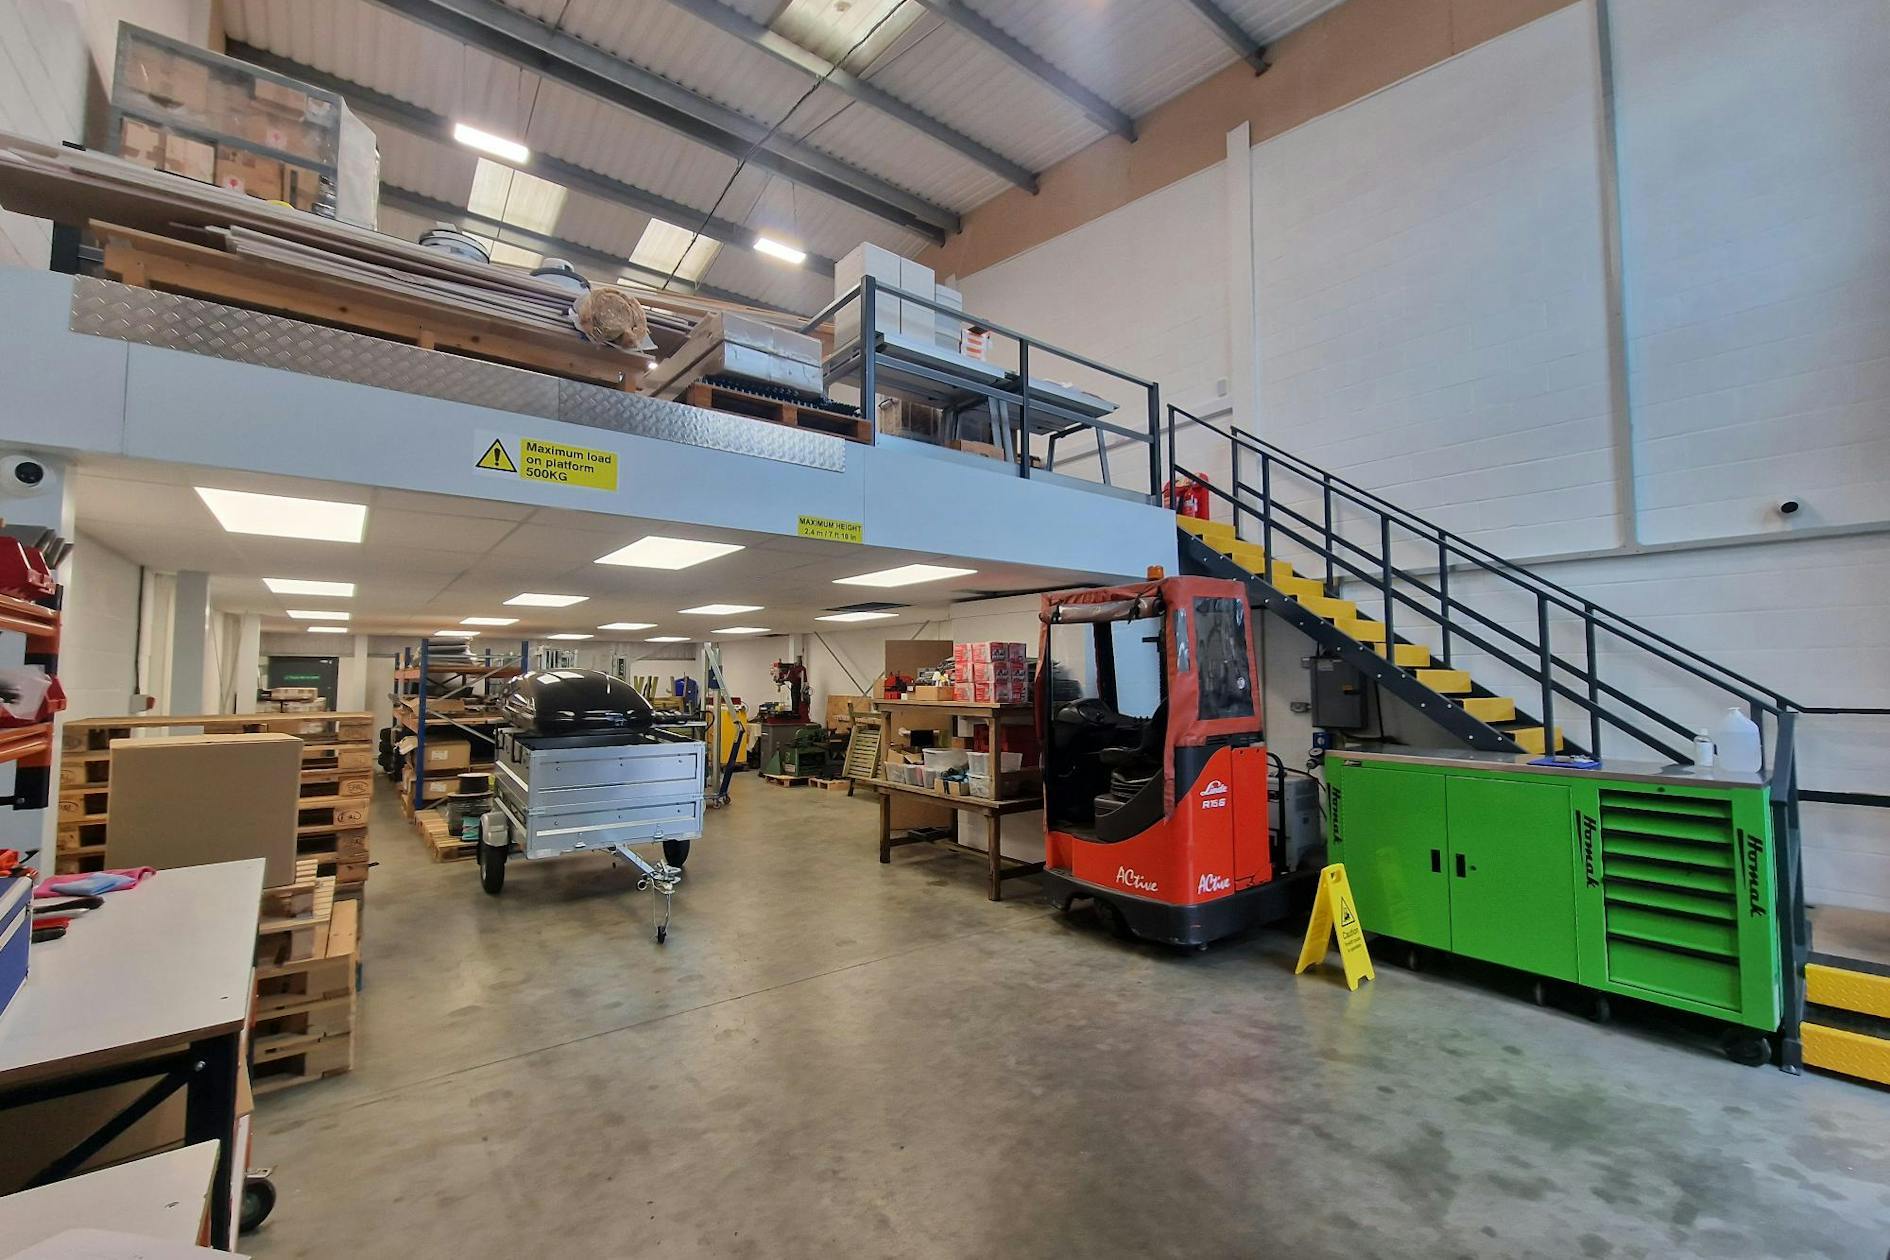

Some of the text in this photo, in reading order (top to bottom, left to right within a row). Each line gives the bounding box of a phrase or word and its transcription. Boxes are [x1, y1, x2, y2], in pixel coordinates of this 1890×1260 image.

[526, 441, 612, 464] Maximum load
[526, 456, 595, 473] on platform
[526, 467, 568, 481] 500KG
[799, 517, 862, 532] MAXIMUM HEIGHT
[804, 527, 815, 535] 2.4
[1332, 786, 1343, 845] Homak
[1583, 814, 1600, 888] Homak
[1115, 865, 1159, 892] ACtive
[1197, 873, 1231, 895] ACtive
[1747, 833, 1766, 918] Homak
